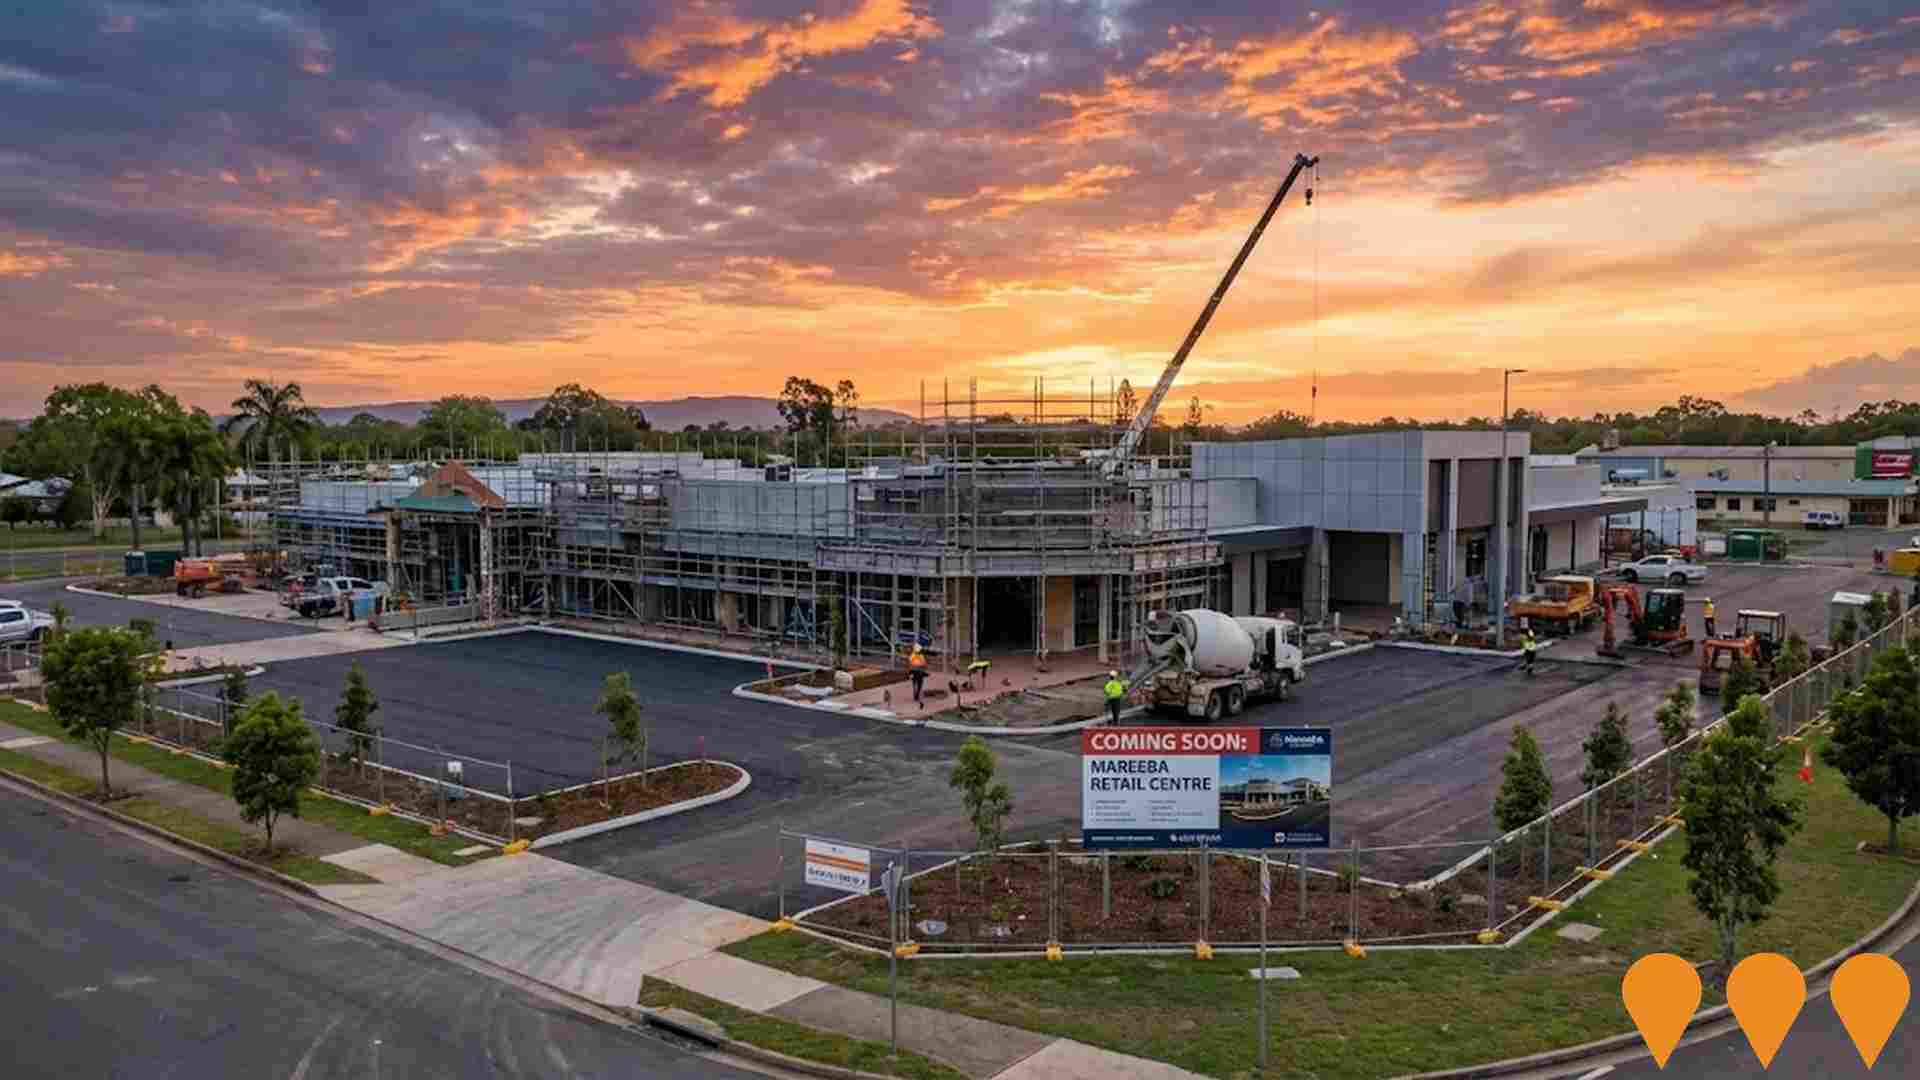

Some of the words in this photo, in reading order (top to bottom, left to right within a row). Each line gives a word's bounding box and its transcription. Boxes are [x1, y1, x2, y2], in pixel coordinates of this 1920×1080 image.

[1090, 733, 1177, 750] COMING
[1181, 733, 1248, 750] SOON:
[1090, 760, 1169, 773] MAREEBA
[1090, 777, 1147, 791] RETAIL
[1149, 777, 1212, 791] CENTRE
